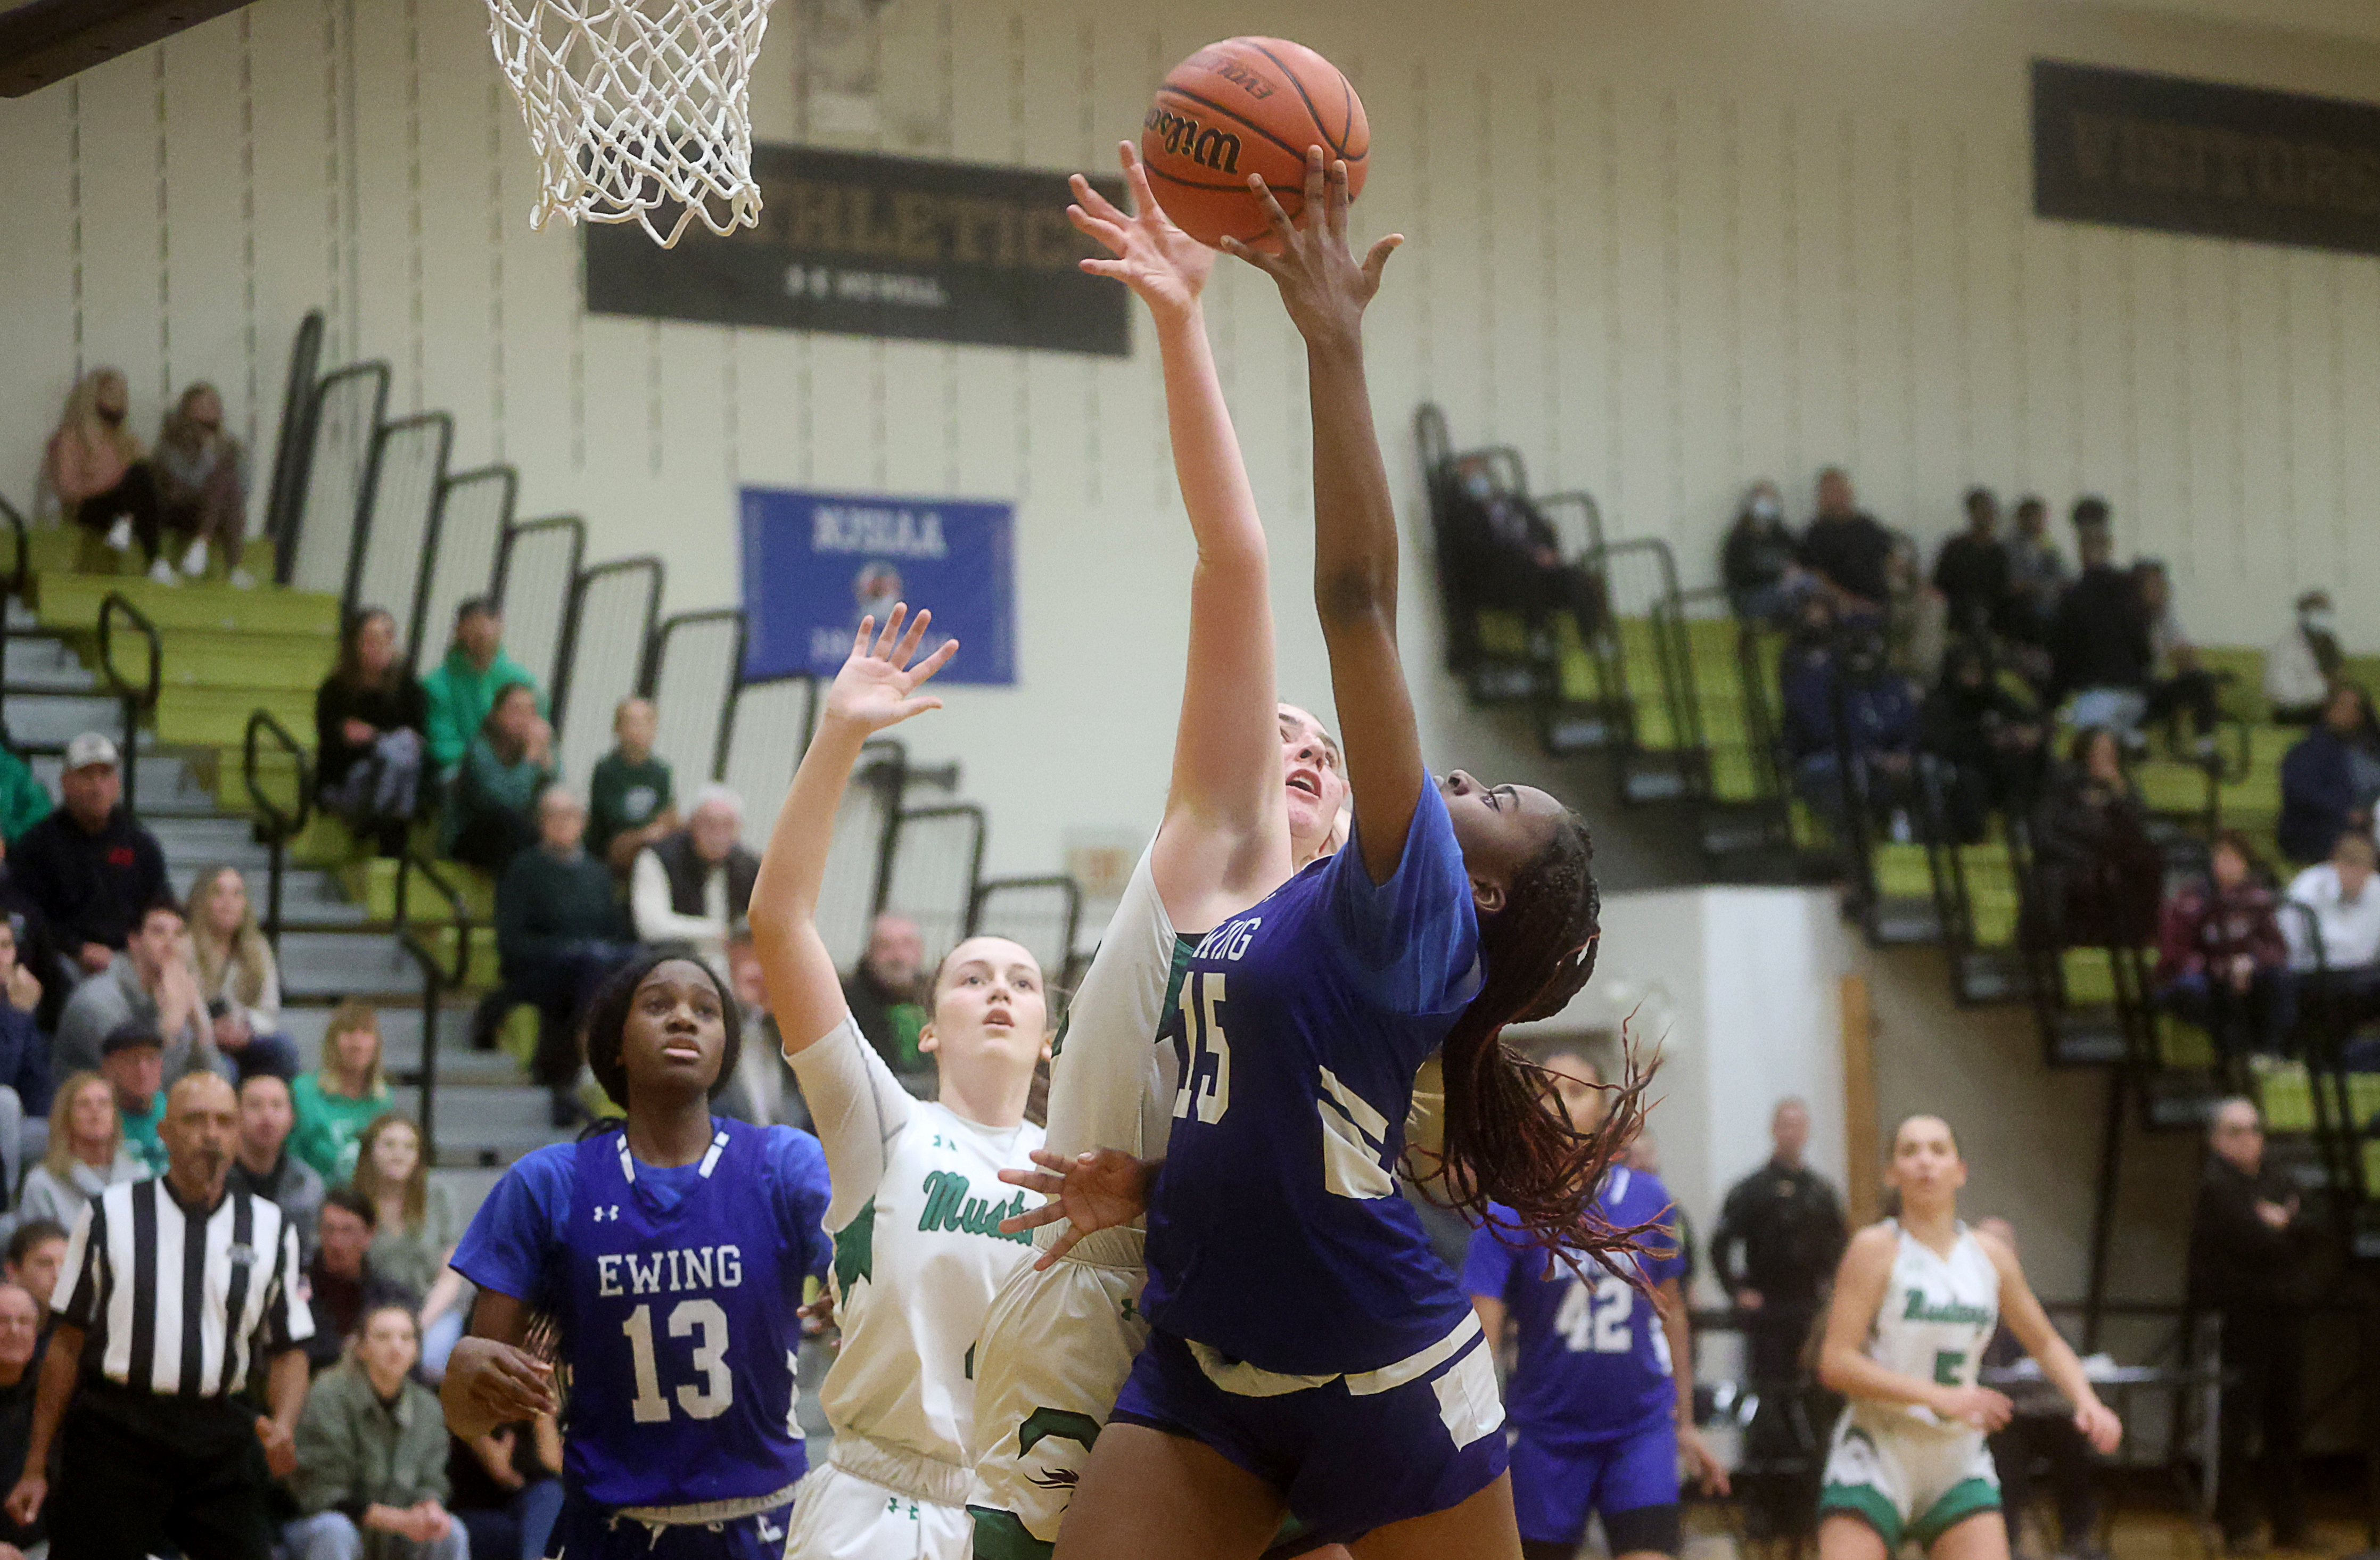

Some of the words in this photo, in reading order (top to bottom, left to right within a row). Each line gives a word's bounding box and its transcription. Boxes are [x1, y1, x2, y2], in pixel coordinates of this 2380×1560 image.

[1173, 971, 1230, 1124] 15
[598, 1244, 742, 1297] EWING
[1553, 1276, 1634, 1353] 42
[622, 1299, 734, 1423] 13
